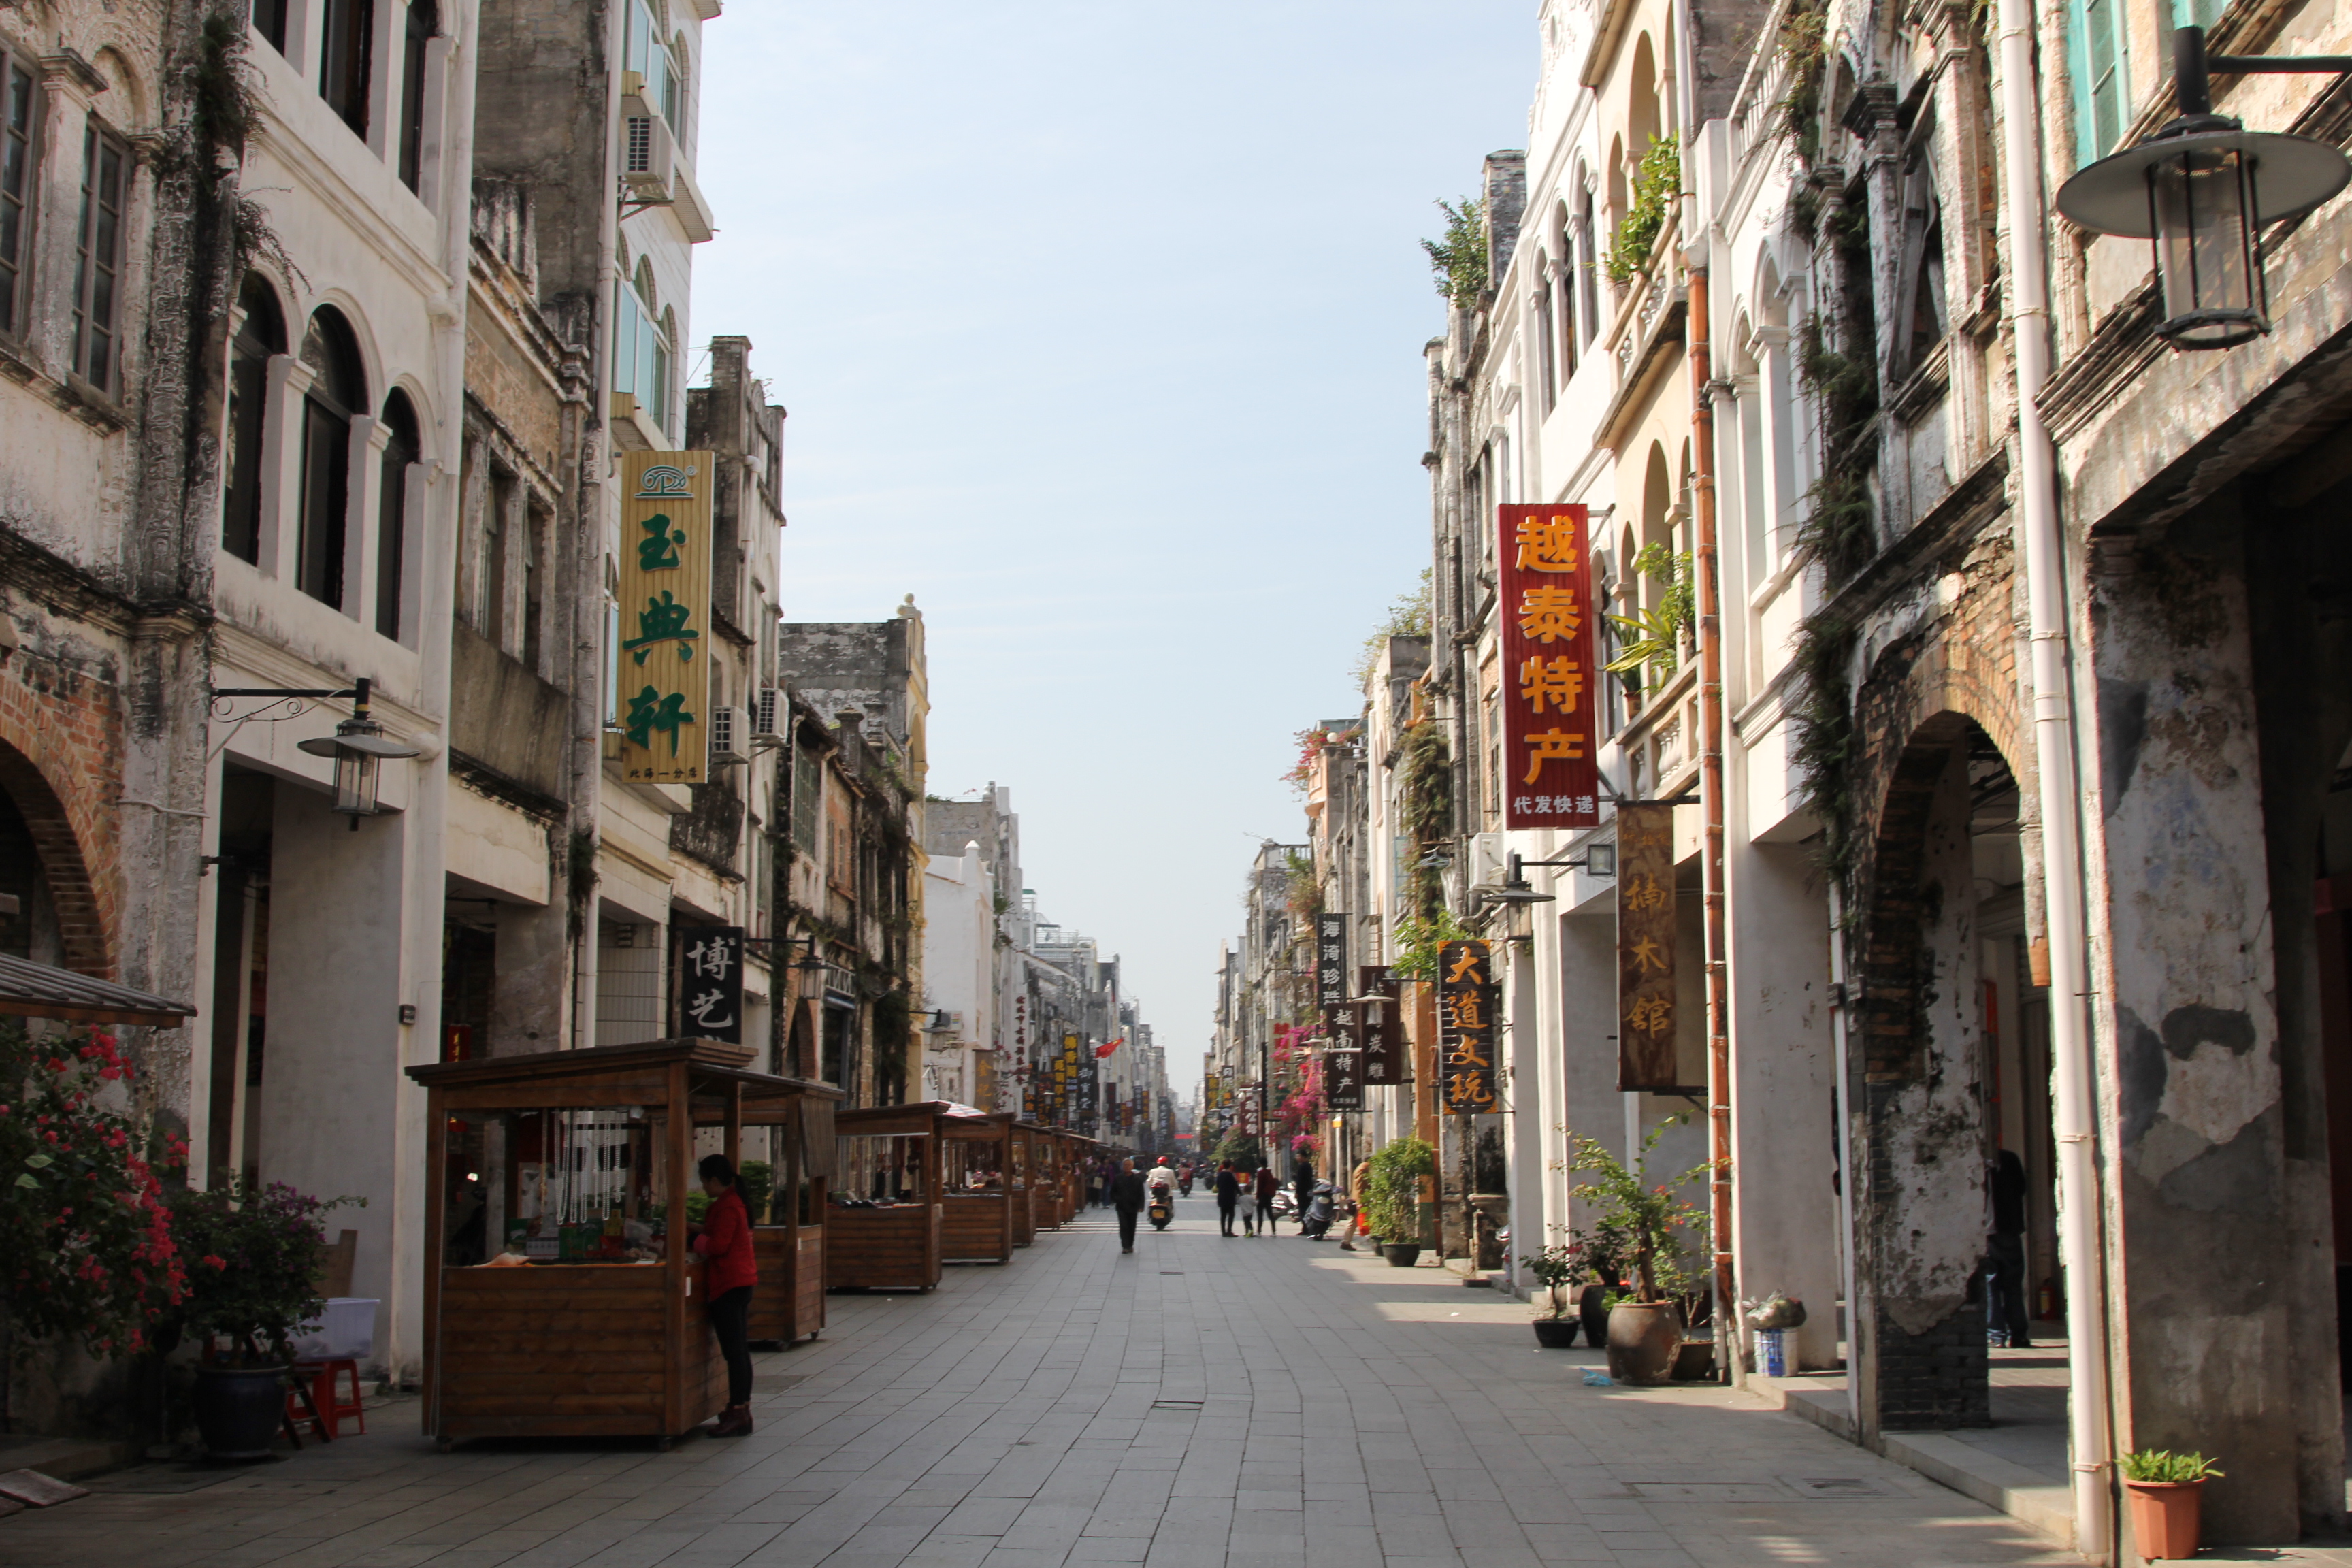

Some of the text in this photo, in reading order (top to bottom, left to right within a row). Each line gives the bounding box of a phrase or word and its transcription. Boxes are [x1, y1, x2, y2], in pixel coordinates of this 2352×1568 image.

[1515, 515, 1584, 786] 越泰特产
[629, 766, 698, 779] 北海一分店
[1514, 795, 1595, 815] 代发快递
[686, 936, 736, 1043] 博艺
[1446, 945, 1494, 1104] 大道文玩
[1333, 1008, 1355, 1094] 越南特产
